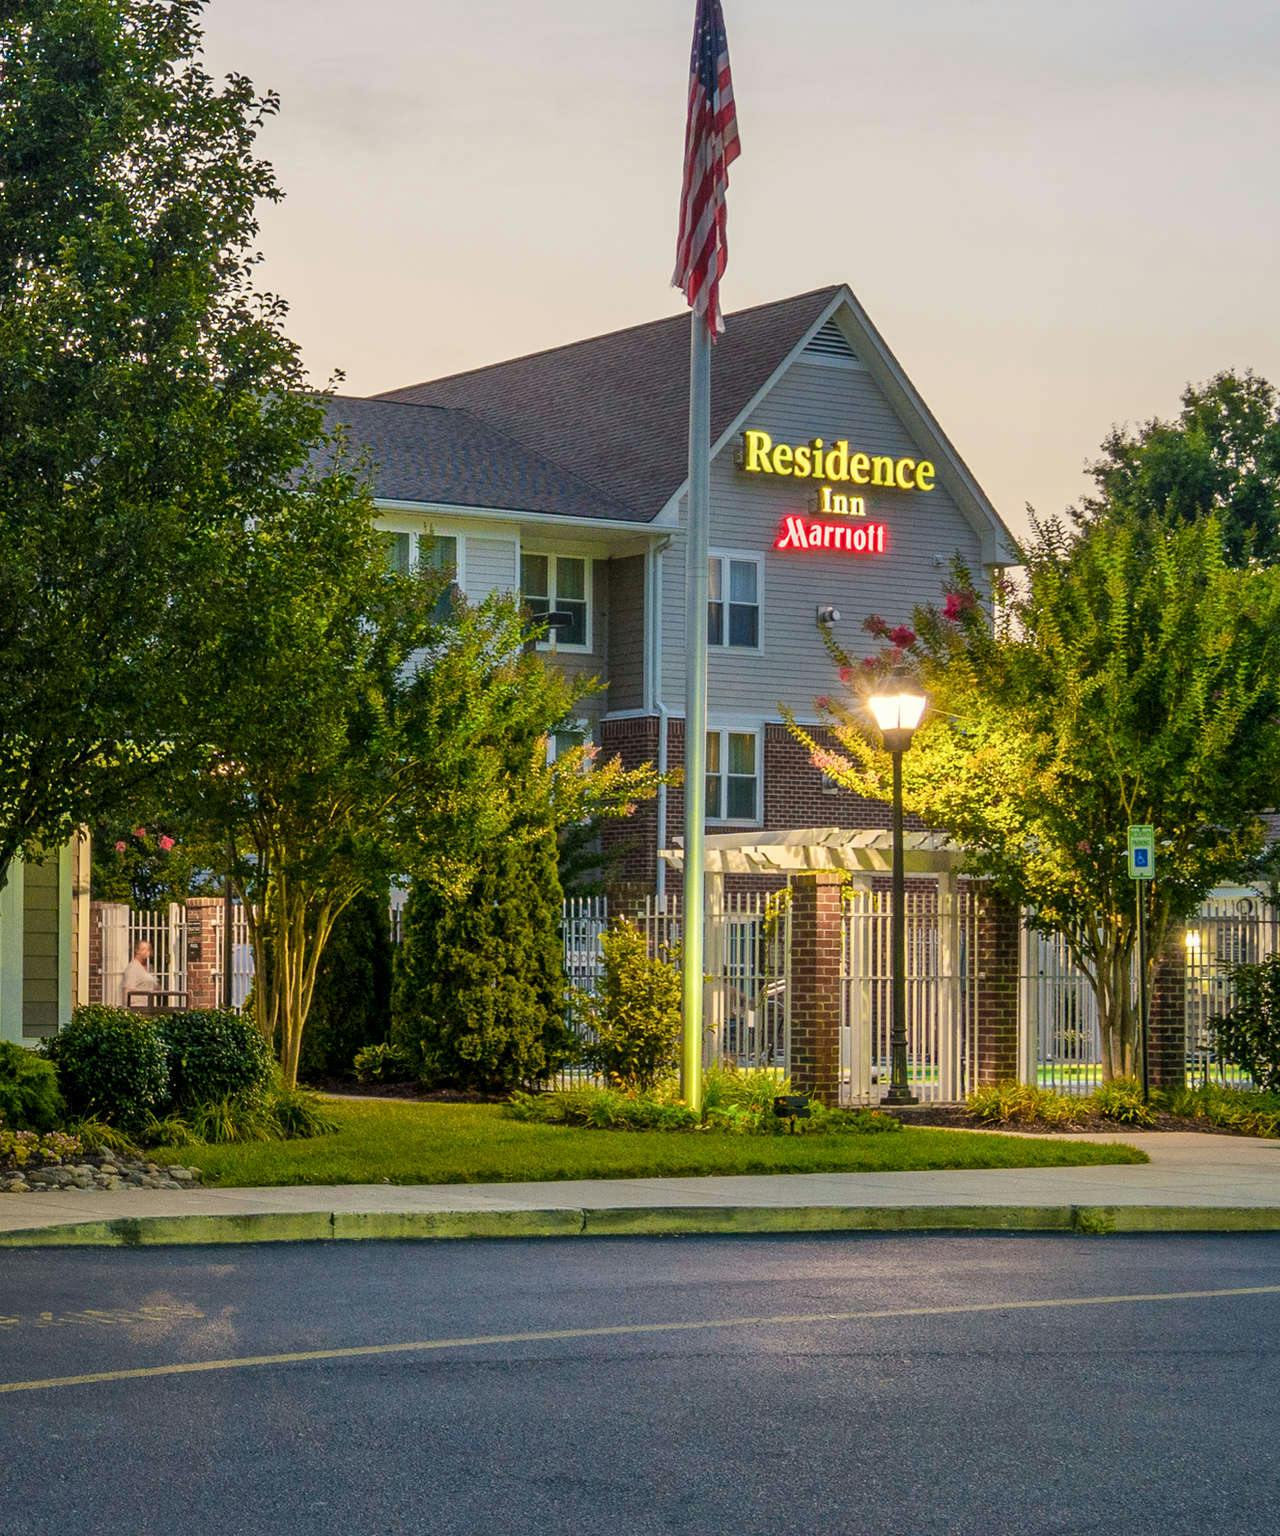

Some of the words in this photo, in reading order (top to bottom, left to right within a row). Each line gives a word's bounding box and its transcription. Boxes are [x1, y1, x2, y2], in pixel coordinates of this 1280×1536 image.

[743, 429, 936, 491] Residence
[821, 486, 867, 516] Inn
[777, 515, 884, 553] Marriott
